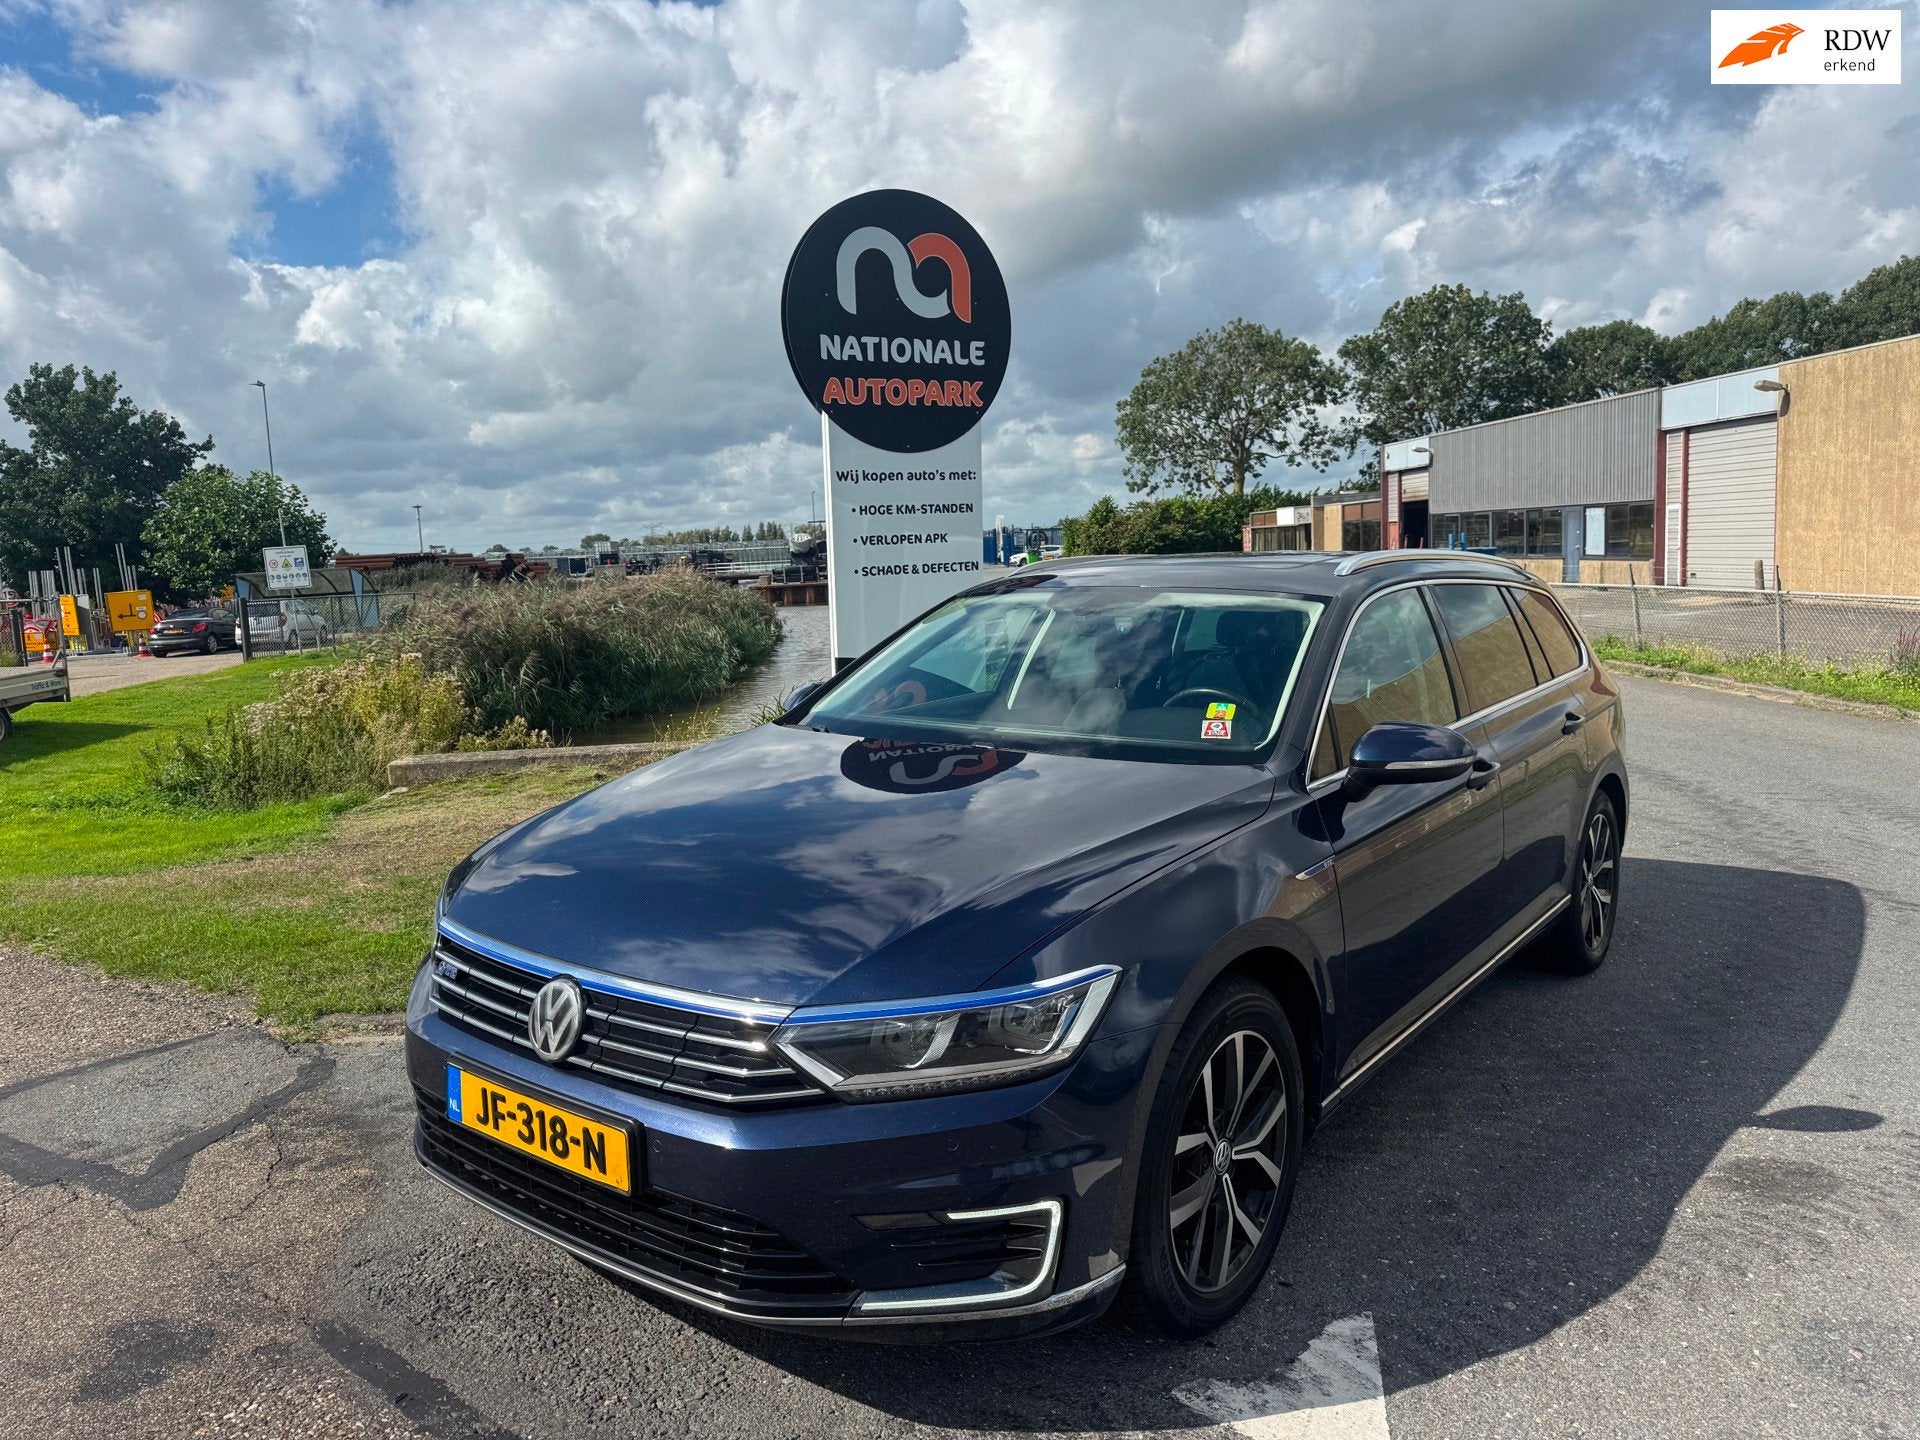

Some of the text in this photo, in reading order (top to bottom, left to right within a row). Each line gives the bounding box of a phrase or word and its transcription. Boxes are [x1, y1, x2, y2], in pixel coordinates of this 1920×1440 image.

[819, 333, 986, 366] NATIONALE
[822, 376, 984, 407] AUTOPARK
[836, 469, 977, 484] Wij kopen auto's met:
[859, 503, 974, 516] HOGE KM-STANDEN
[860, 533, 949, 546] VERLOPEN APK
[861, 561, 979, 577] SCHADE & DEFECTEN
[449, 1096, 461, 1113] NL
[476, 1086, 608, 1176] JF-318-N
